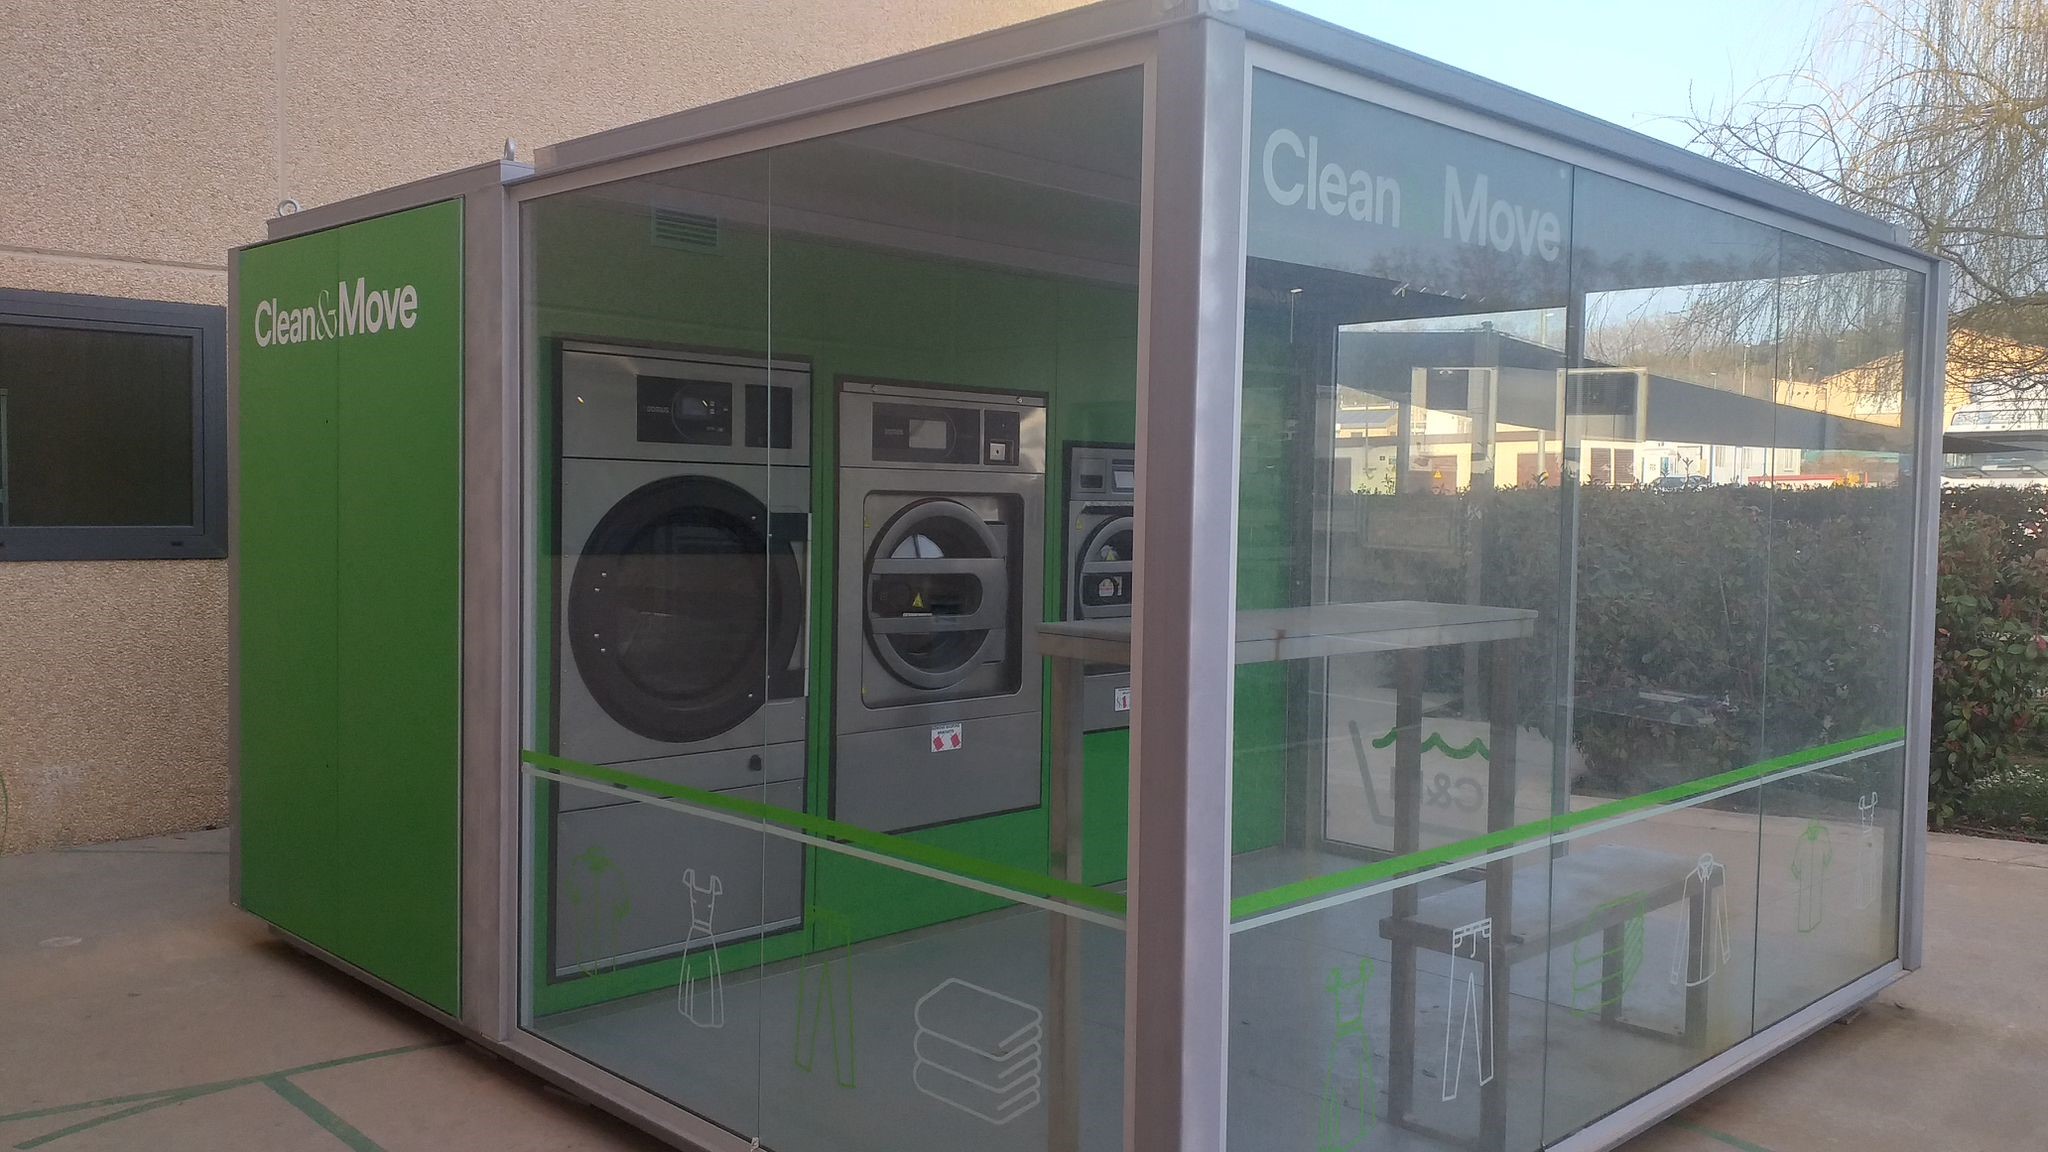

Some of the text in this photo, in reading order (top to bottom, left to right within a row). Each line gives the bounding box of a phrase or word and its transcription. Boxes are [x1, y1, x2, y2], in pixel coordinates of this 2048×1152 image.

[1262, 128, 1561, 263] Clean Move
[254, 277, 418, 348] Clean&Move
